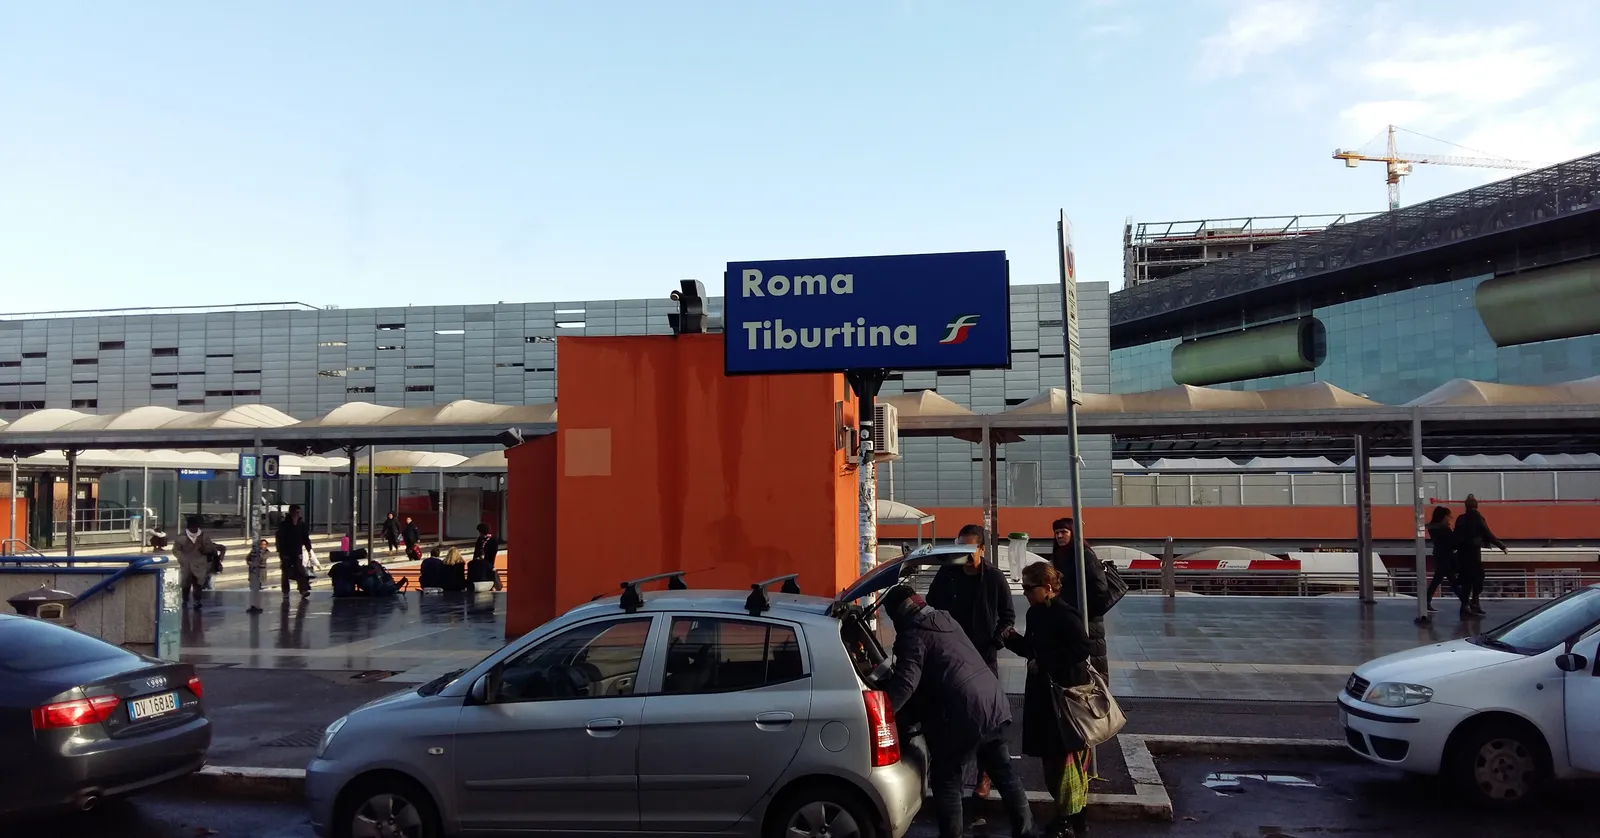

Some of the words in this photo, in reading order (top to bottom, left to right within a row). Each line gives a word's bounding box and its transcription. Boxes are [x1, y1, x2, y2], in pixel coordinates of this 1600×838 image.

[742, 268, 854, 297] Roma
[742, 317, 918, 351] Tiburtina
[135, 699, 148, 717] DV
[149, 695, 175, 713] 168AB
